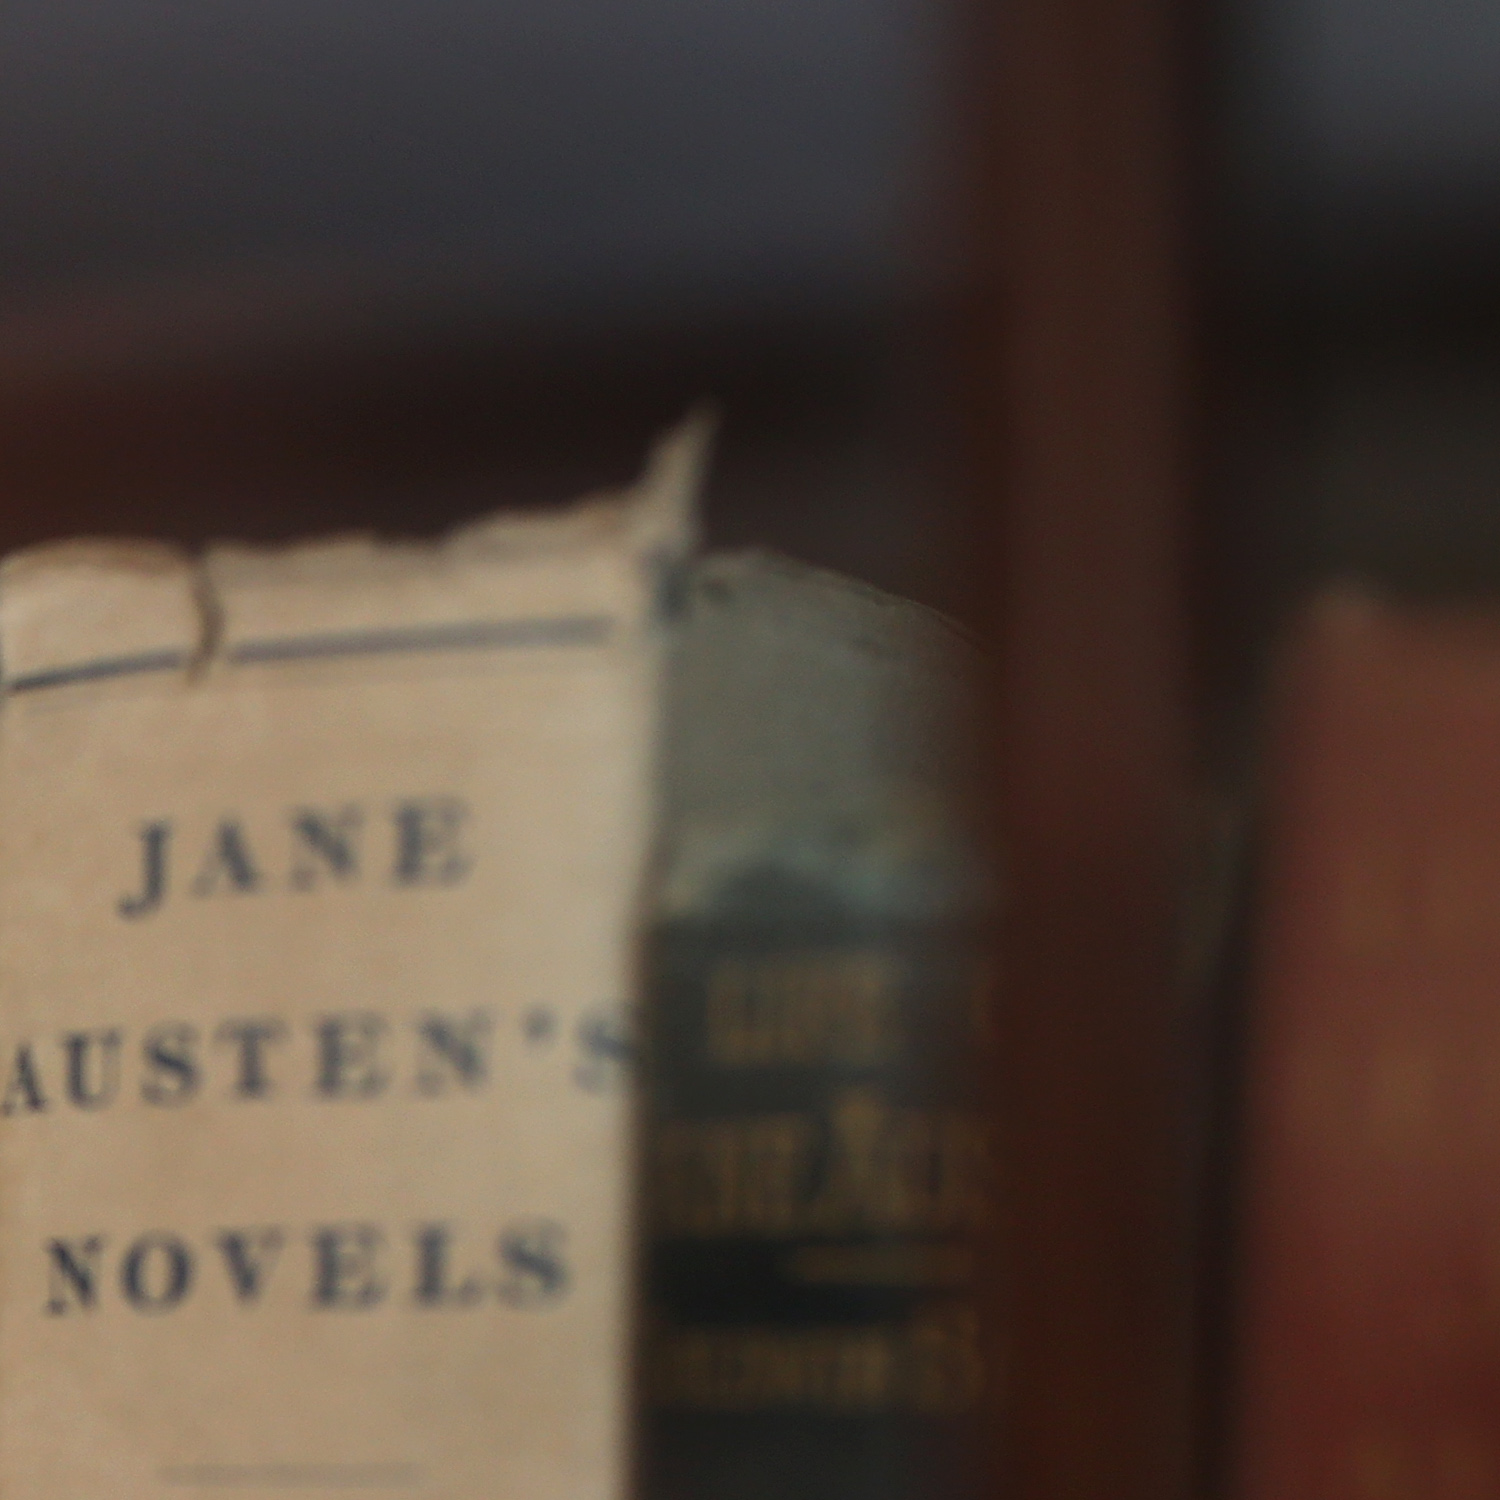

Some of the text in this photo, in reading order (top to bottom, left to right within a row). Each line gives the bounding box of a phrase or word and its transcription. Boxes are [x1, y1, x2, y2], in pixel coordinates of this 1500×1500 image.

[117, 796, 470, 921] JANE
[1, 1002, 640, 1117] AUSTEN'S
[45, 1220, 570, 1316] NOVELS
